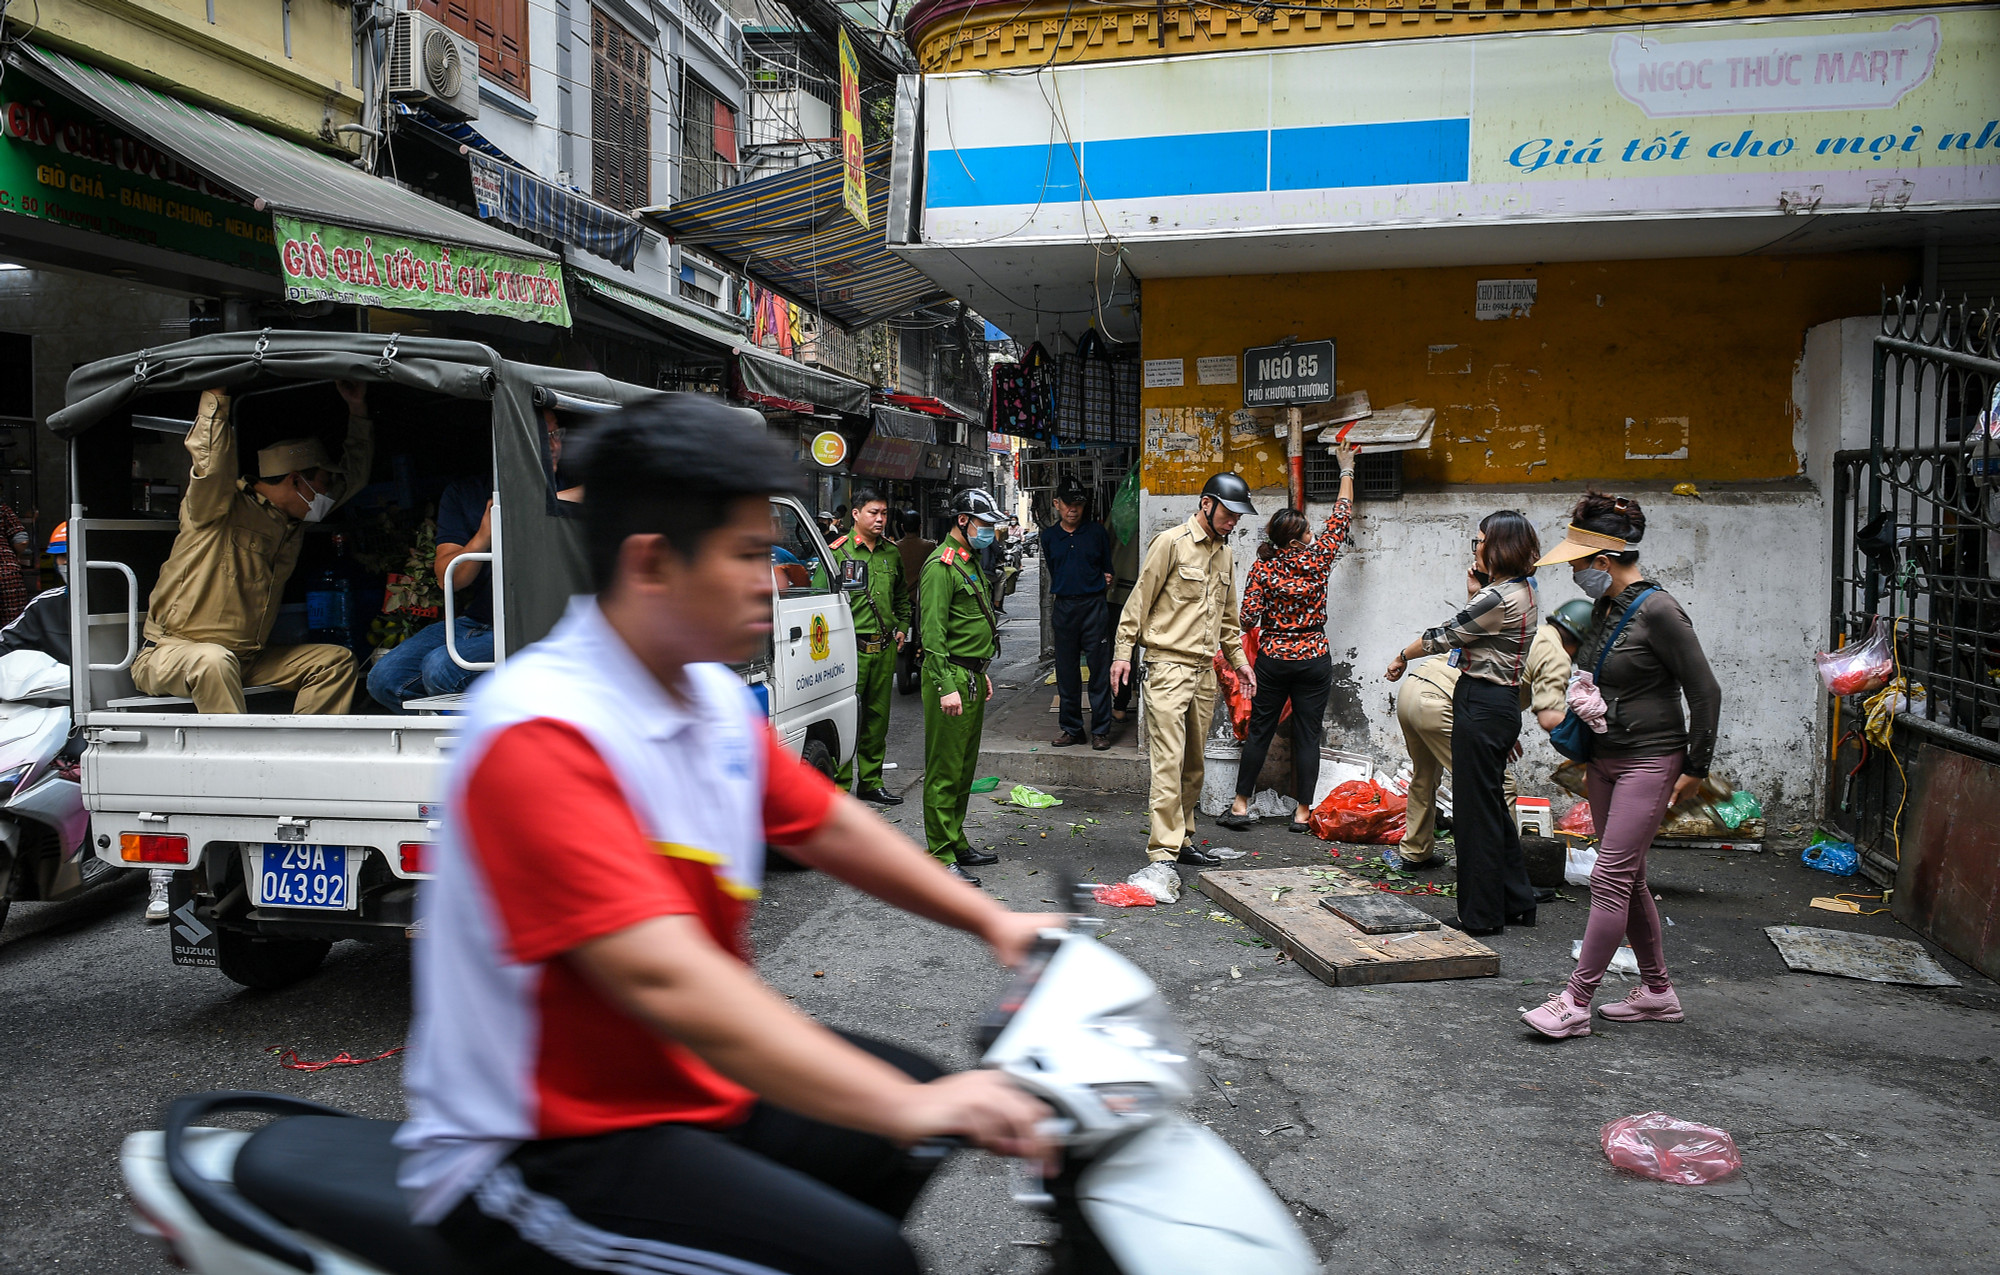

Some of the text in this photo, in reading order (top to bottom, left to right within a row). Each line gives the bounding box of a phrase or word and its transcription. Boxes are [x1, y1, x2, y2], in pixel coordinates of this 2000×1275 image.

[1639, 48, 1909, 97] NGỌC THỨC MART
[1503, 138, 1606, 174] Giá
[1621, 131, 1690, 162] tốt
[1707, 130, 1800, 159] cho
[1815, 125, 1924, 161] mọi
[21, 195, 38, 212] 50
[37, 162, 66, 189] GIÒ
[70, 173, 105, 199] CHẢ
[121, 186, 163, 215] BÁNH
[225, 216, 254, 240] NEM
[283, 233, 328, 279] GIÒ
[333, 237, 381, 287] CHẢ
[458, 266, 491, 299] GIA
[494, 263, 562, 307] TRUYỀN
[1478, 285, 1493, 300] CHO
[1259, 351, 1292, 380] NGÕ
[1297, 354, 1318, 378] 85
[1265, 385, 1296, 400] KHƯƠNG
[1297, 382, 1329, 400] THƯỢNG
[796, 674, 814, 690] CÔNG
[815, 671, 822, 684] AN
[281, 844, 326, 871] 29A
[263, 871, 343, 905] 043.92
[175, 945, 216, 956] SUZUKI
